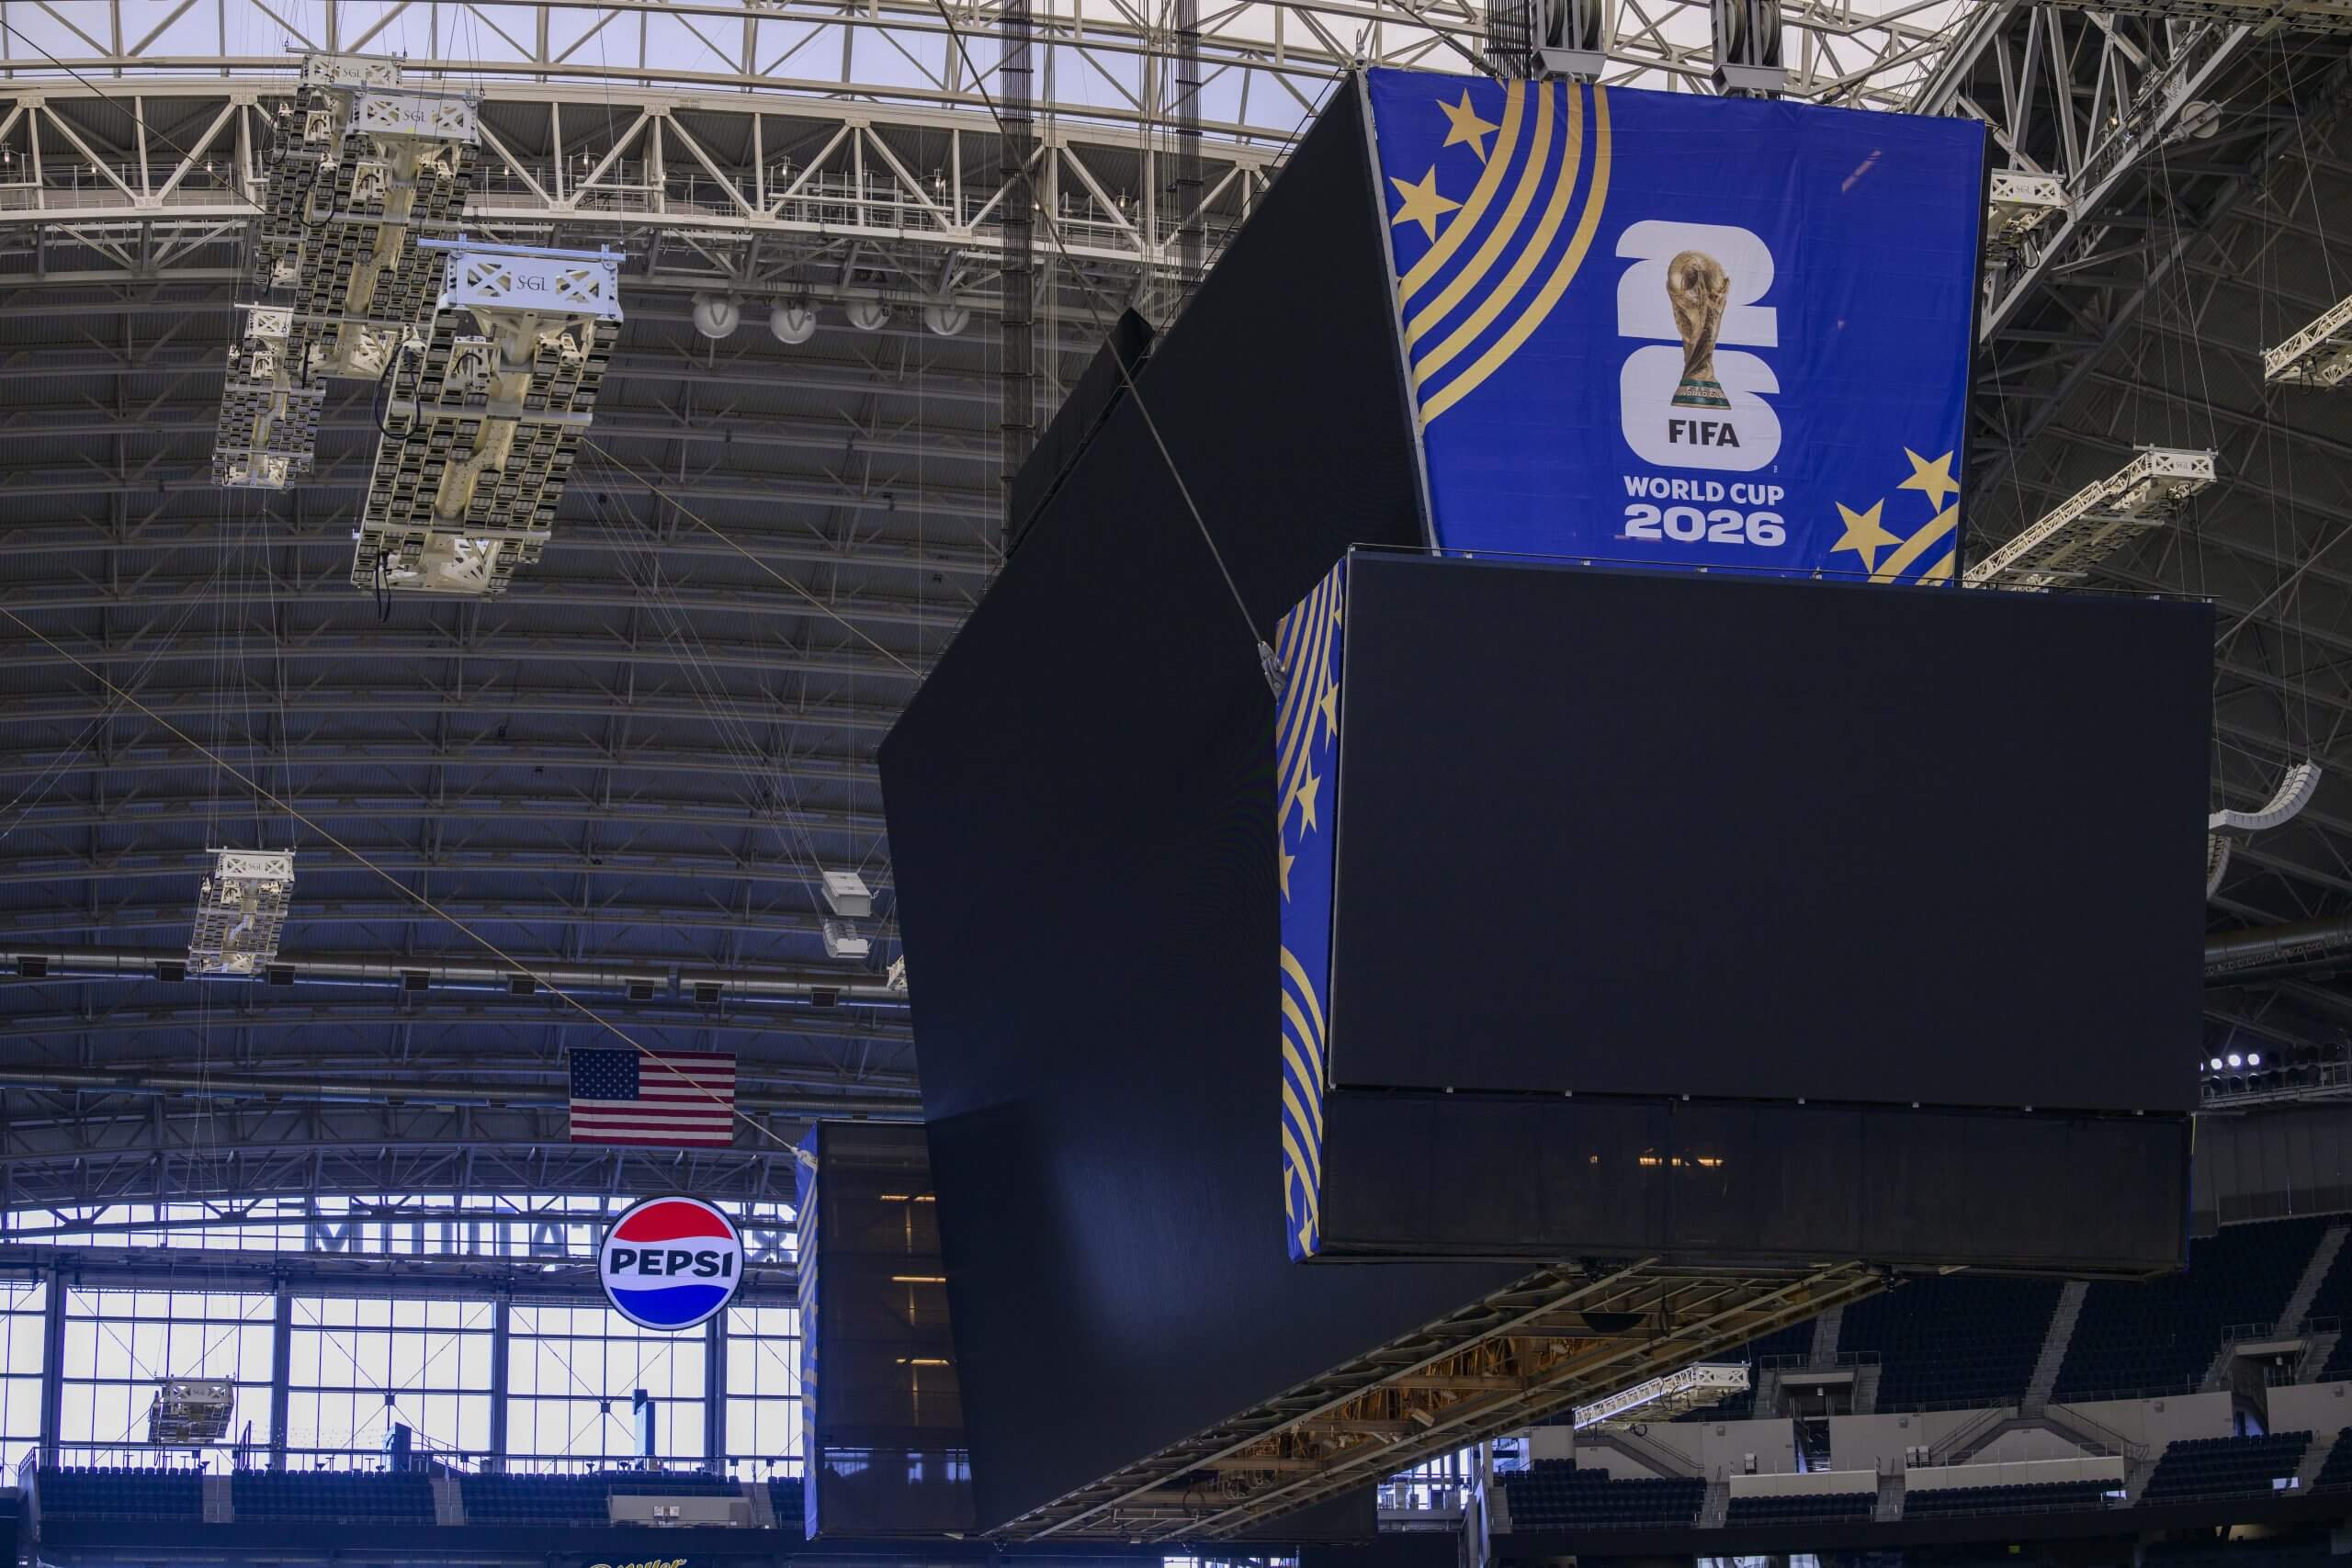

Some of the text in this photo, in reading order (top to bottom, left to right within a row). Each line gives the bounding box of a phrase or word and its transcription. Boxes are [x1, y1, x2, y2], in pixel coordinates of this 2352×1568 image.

[343, 67, 360, 78] SGL
[403, 110, 426, 122] SGL
[516, 275, 548, 291] SGL
[1668, 419, 1740, 447] FIFA
[1623, 476, 1785, 505] WORLD CUP
[1624, 503, 1786, 547] 2026
[610, 1248, 733, 1277] PEPSI
